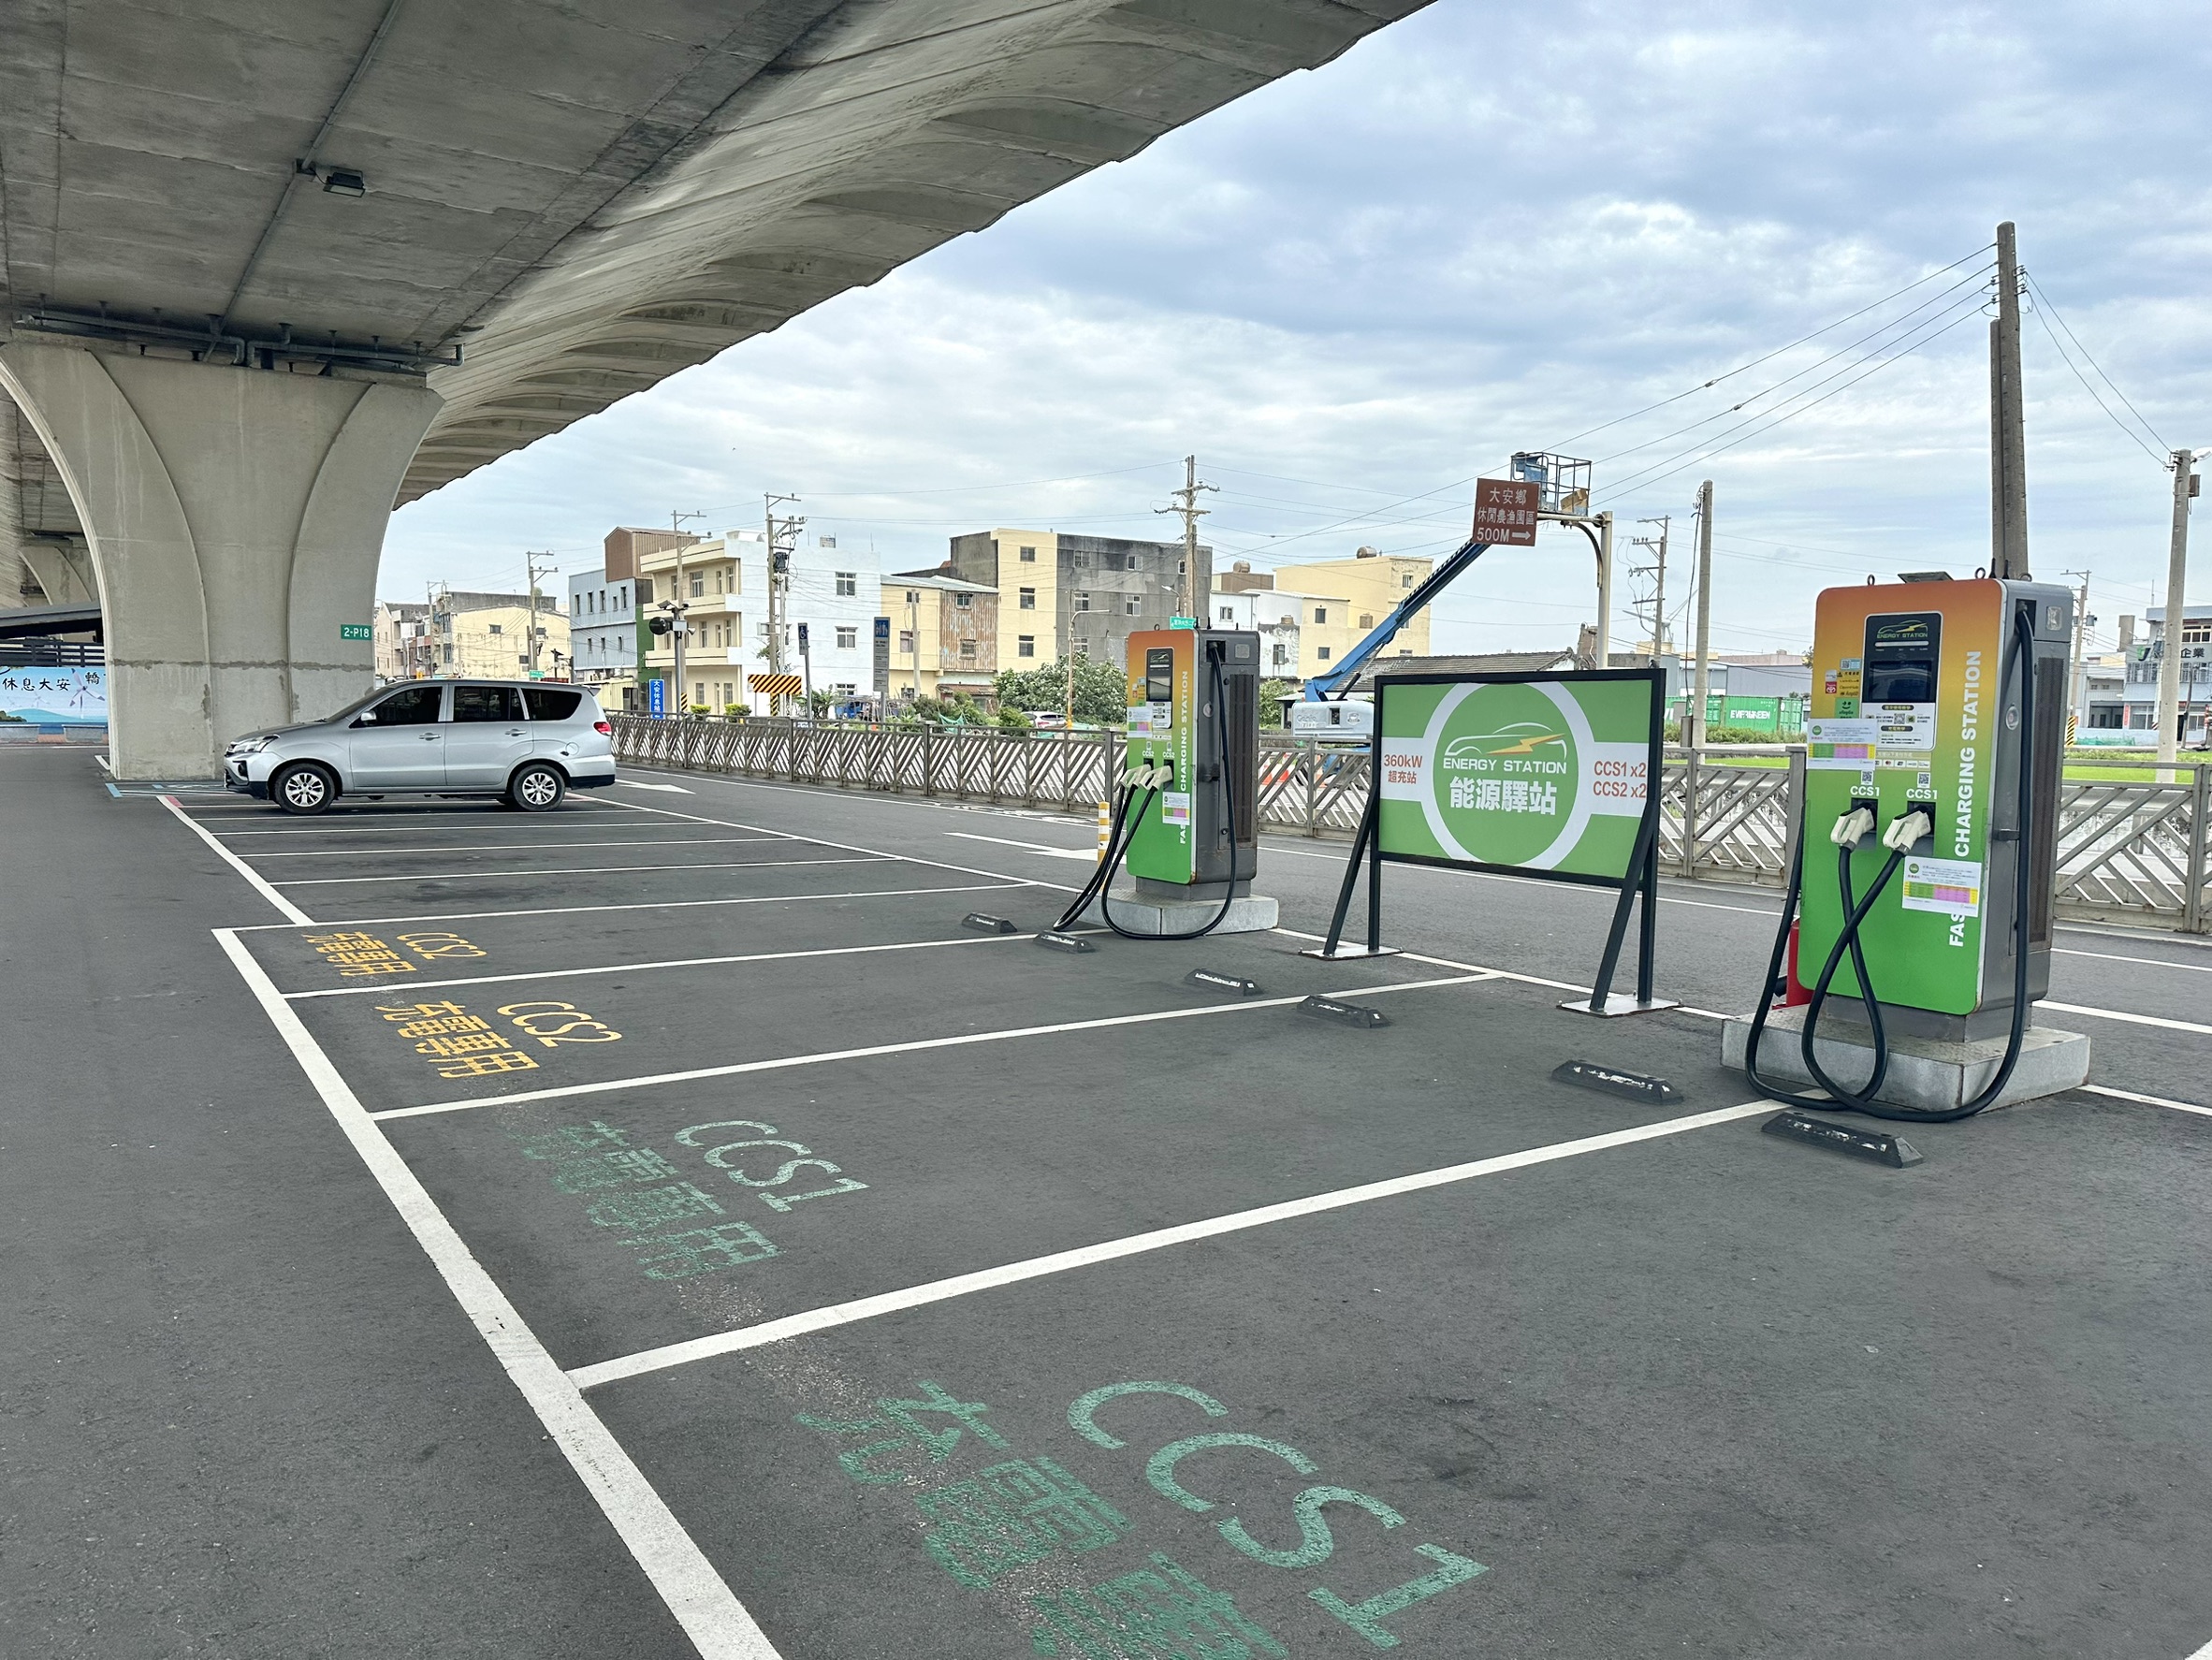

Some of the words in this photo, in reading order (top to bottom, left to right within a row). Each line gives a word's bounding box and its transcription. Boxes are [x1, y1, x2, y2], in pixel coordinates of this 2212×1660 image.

[1489, 487, 1527, 505] 大安鄉
[1477, 527, 1509, 542] 500M
[344, 627, 370, 637] 2-P18
[2180, 648, 2205, 658] 企業
[2, 677, 71, 691] 休息大安
[1961, 650, 1982, 741] STATION
[1729, 709, 1770, 720] EVERGREEN
[1384, 754, 1422, 768] 360kW
[1443, 757, 1497, 771] ENERGY
[1503, 760, 1567, 775] STATION
[1594, 760, 1627, 777] CCS1
[1630, 762, 1647, 778] x2
[1388, 770, 1418, 784] 超充站
[1449, 775, 1558, 816] 能源驛站
[1593, 780, 1627, 797] CCS2
[1630, 782, 1647, 798] x2
[1850, 785, 1880, 797] CCS1
[1905, 788, 1938, 800] CCS1
[1955, 747, 1975, 857] CHARGING
[1949, 913, 1966, 947] FAS
[397, 932, 487, 960] CCS2
[497, 1000, 622, 1048] CCS2
[374, 1000, 541, 1078] 充電專用
[674, 1120, 870, 1213] CCS1
[793, 1379, 1291, 1659] 充電專
[1067, 1380, 1491, 1650] CCS1
